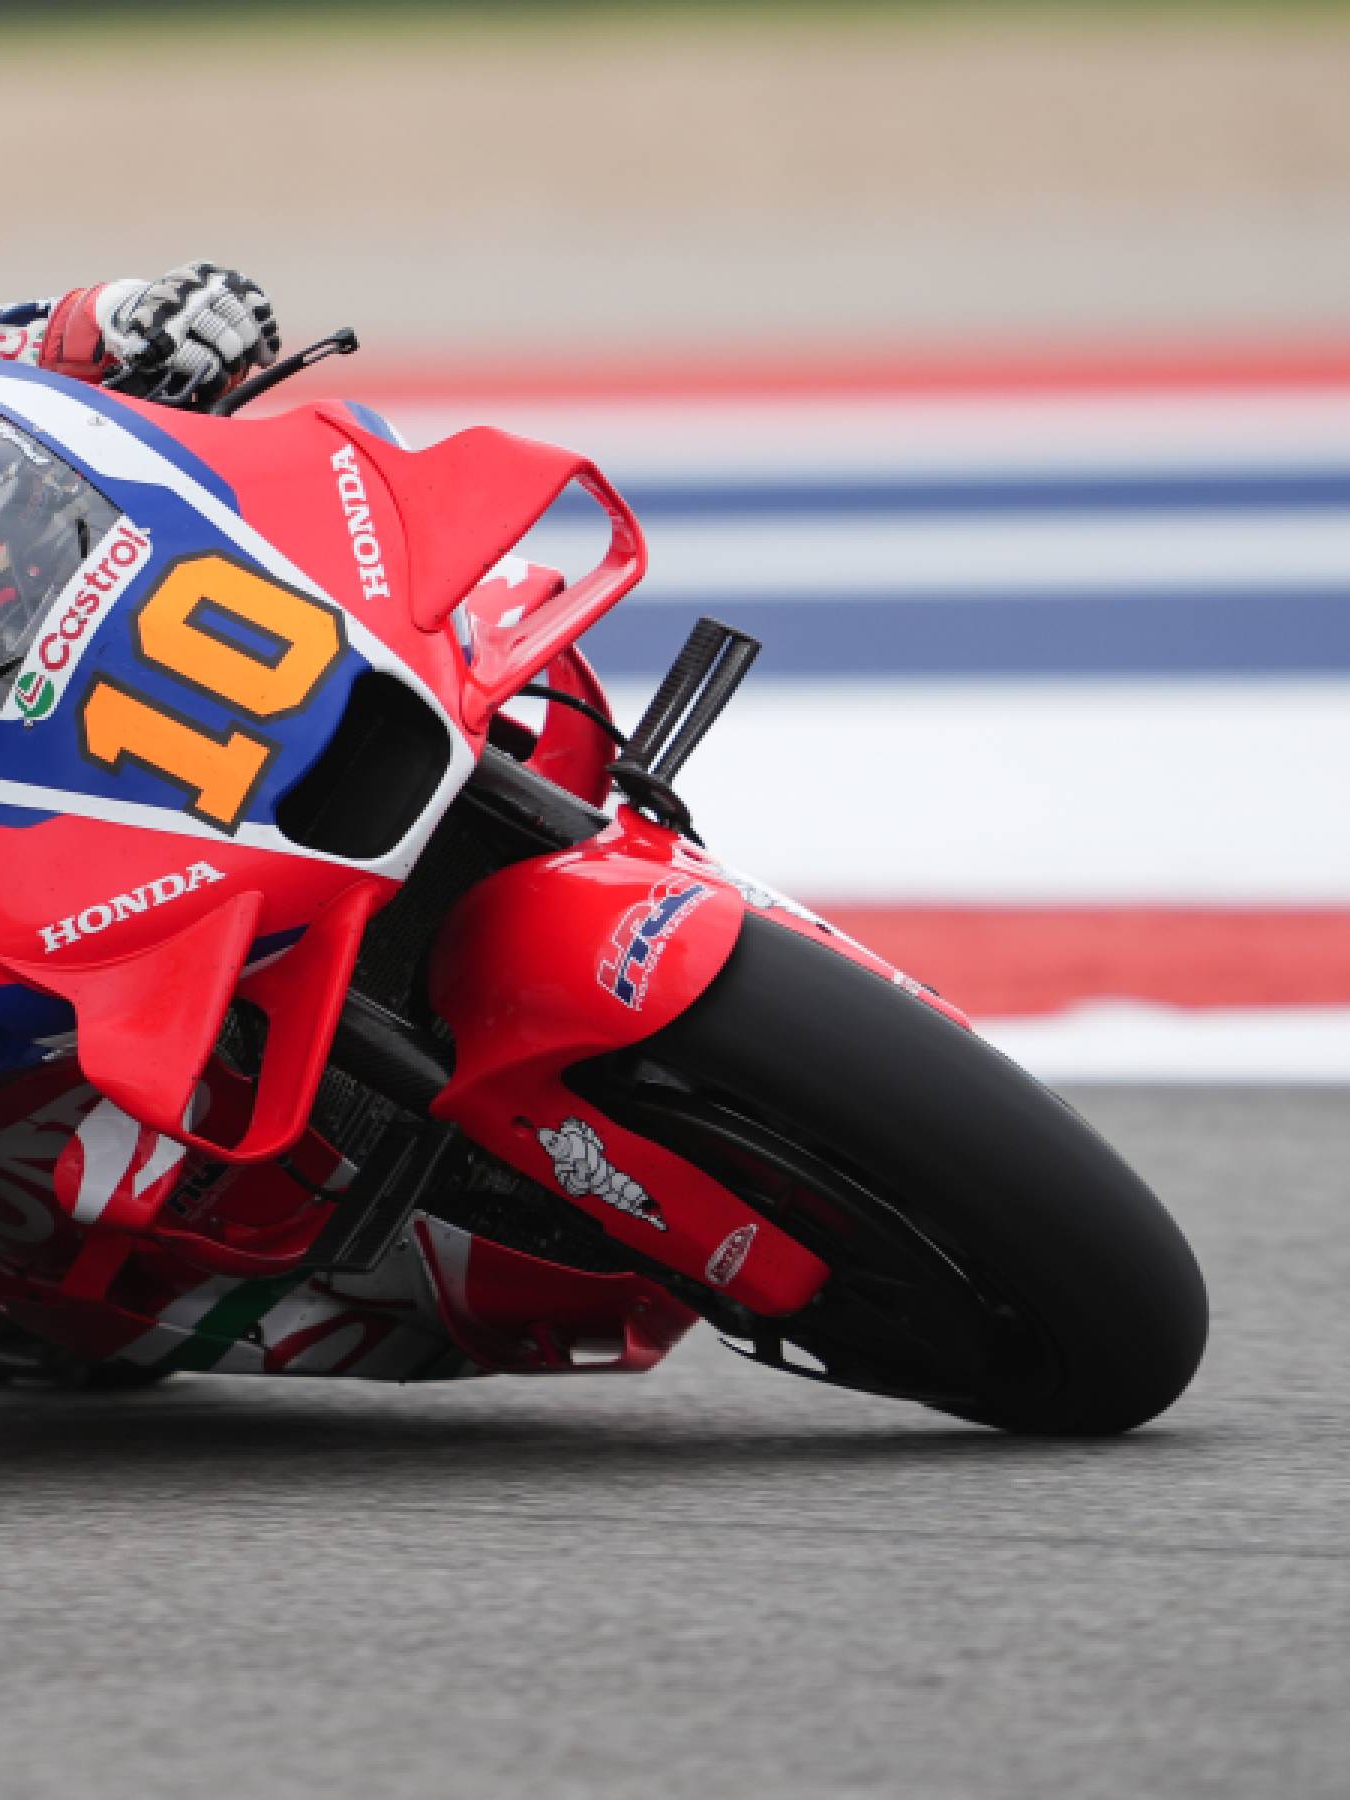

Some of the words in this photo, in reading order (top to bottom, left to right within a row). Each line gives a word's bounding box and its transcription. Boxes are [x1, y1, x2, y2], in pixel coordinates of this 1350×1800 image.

[330, 443, 390, 600] HONDA
[38, 525, 150, 672] Castrol
[76, 549, 347, 838] 10
[37, 860, 226, 954] HONDA
